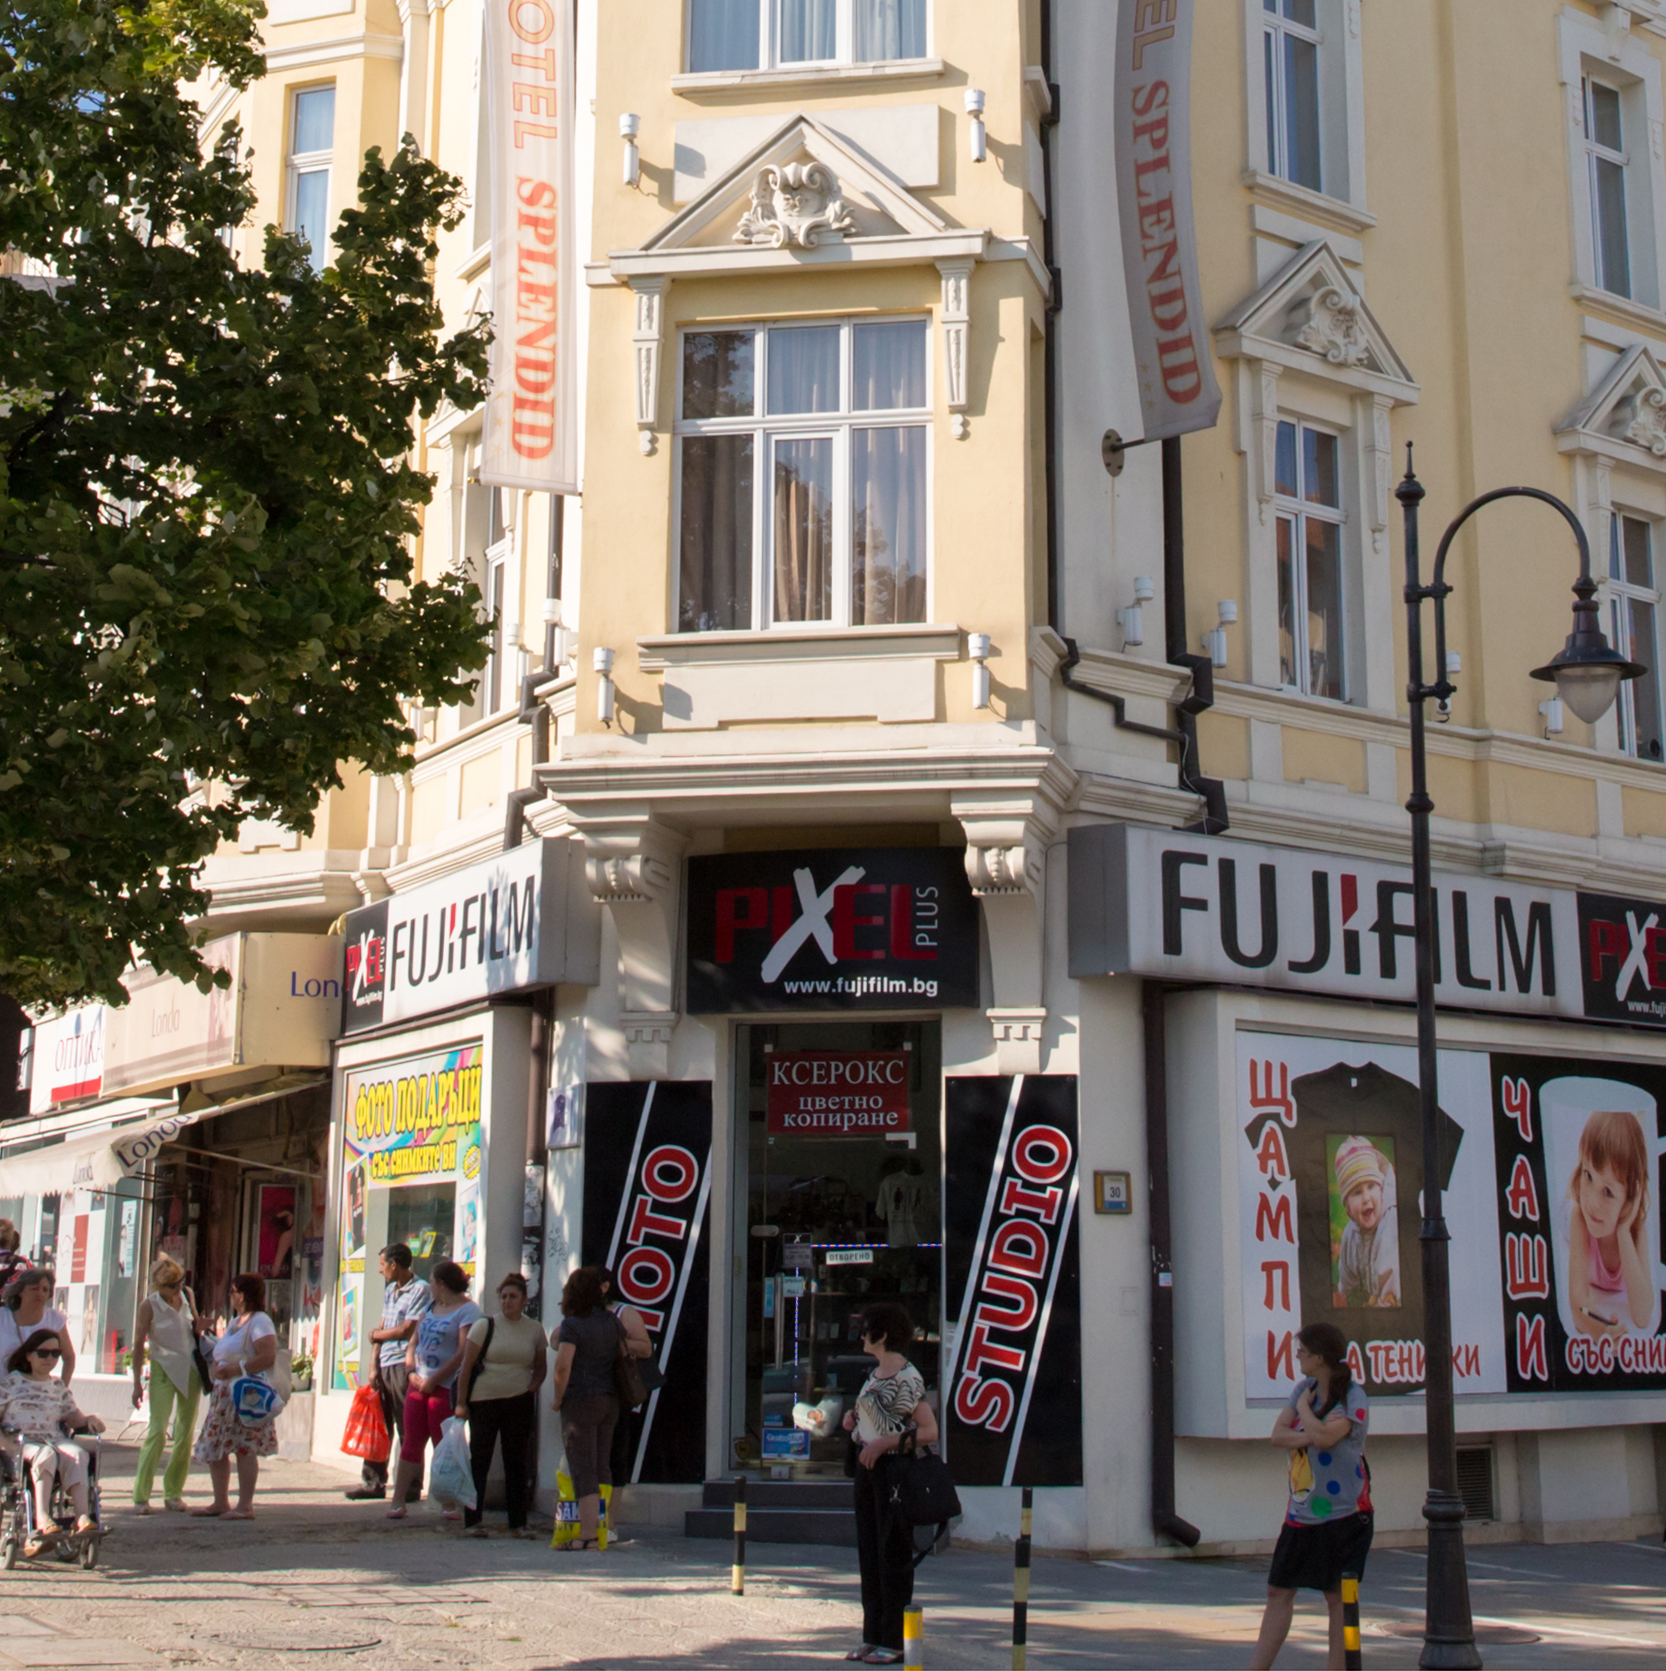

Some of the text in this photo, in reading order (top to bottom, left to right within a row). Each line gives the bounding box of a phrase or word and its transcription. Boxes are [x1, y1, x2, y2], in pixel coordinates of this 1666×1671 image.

[1130, 78, 1204, 407] SPLENDID
[510, 174, 559, 462] SPLENDID
[389, 873, 537, 992] FUJIFILM
[714, 865, 938, 984] PIXEL
[915, 885, 939, 947] PLUS
[1160, 849, 1557, 998] FUJIFILM
[290, 970, 340, 999] Lon
[346, 928, 384, 1003] PIXEL
[783, 975, 939, 998] www.fujifilm.bg
[355, 1064, 482, 1142] ФОТО ПОДАРЪЦИ
[771, 1058, 906, 1086] КСЕРОКС
[798, 1093, 884, 1111] цветно
[782, 1109, 900, 1131] копиране
[1109, 1185, 1122, 1200] 30
[1248, 1057, 1297, 1382] ЩАМПИ
[828, 1252, 872, 1262] ОТВОРЕНО
[1501, 1074, 1550, 1382] ЧАШИ
[954, 1123, 1073, 1434] STUDIO
[1345, 1342, 1481, 1384] А ТЕНИКИ
[555, 1501, 580, 1521] SA
